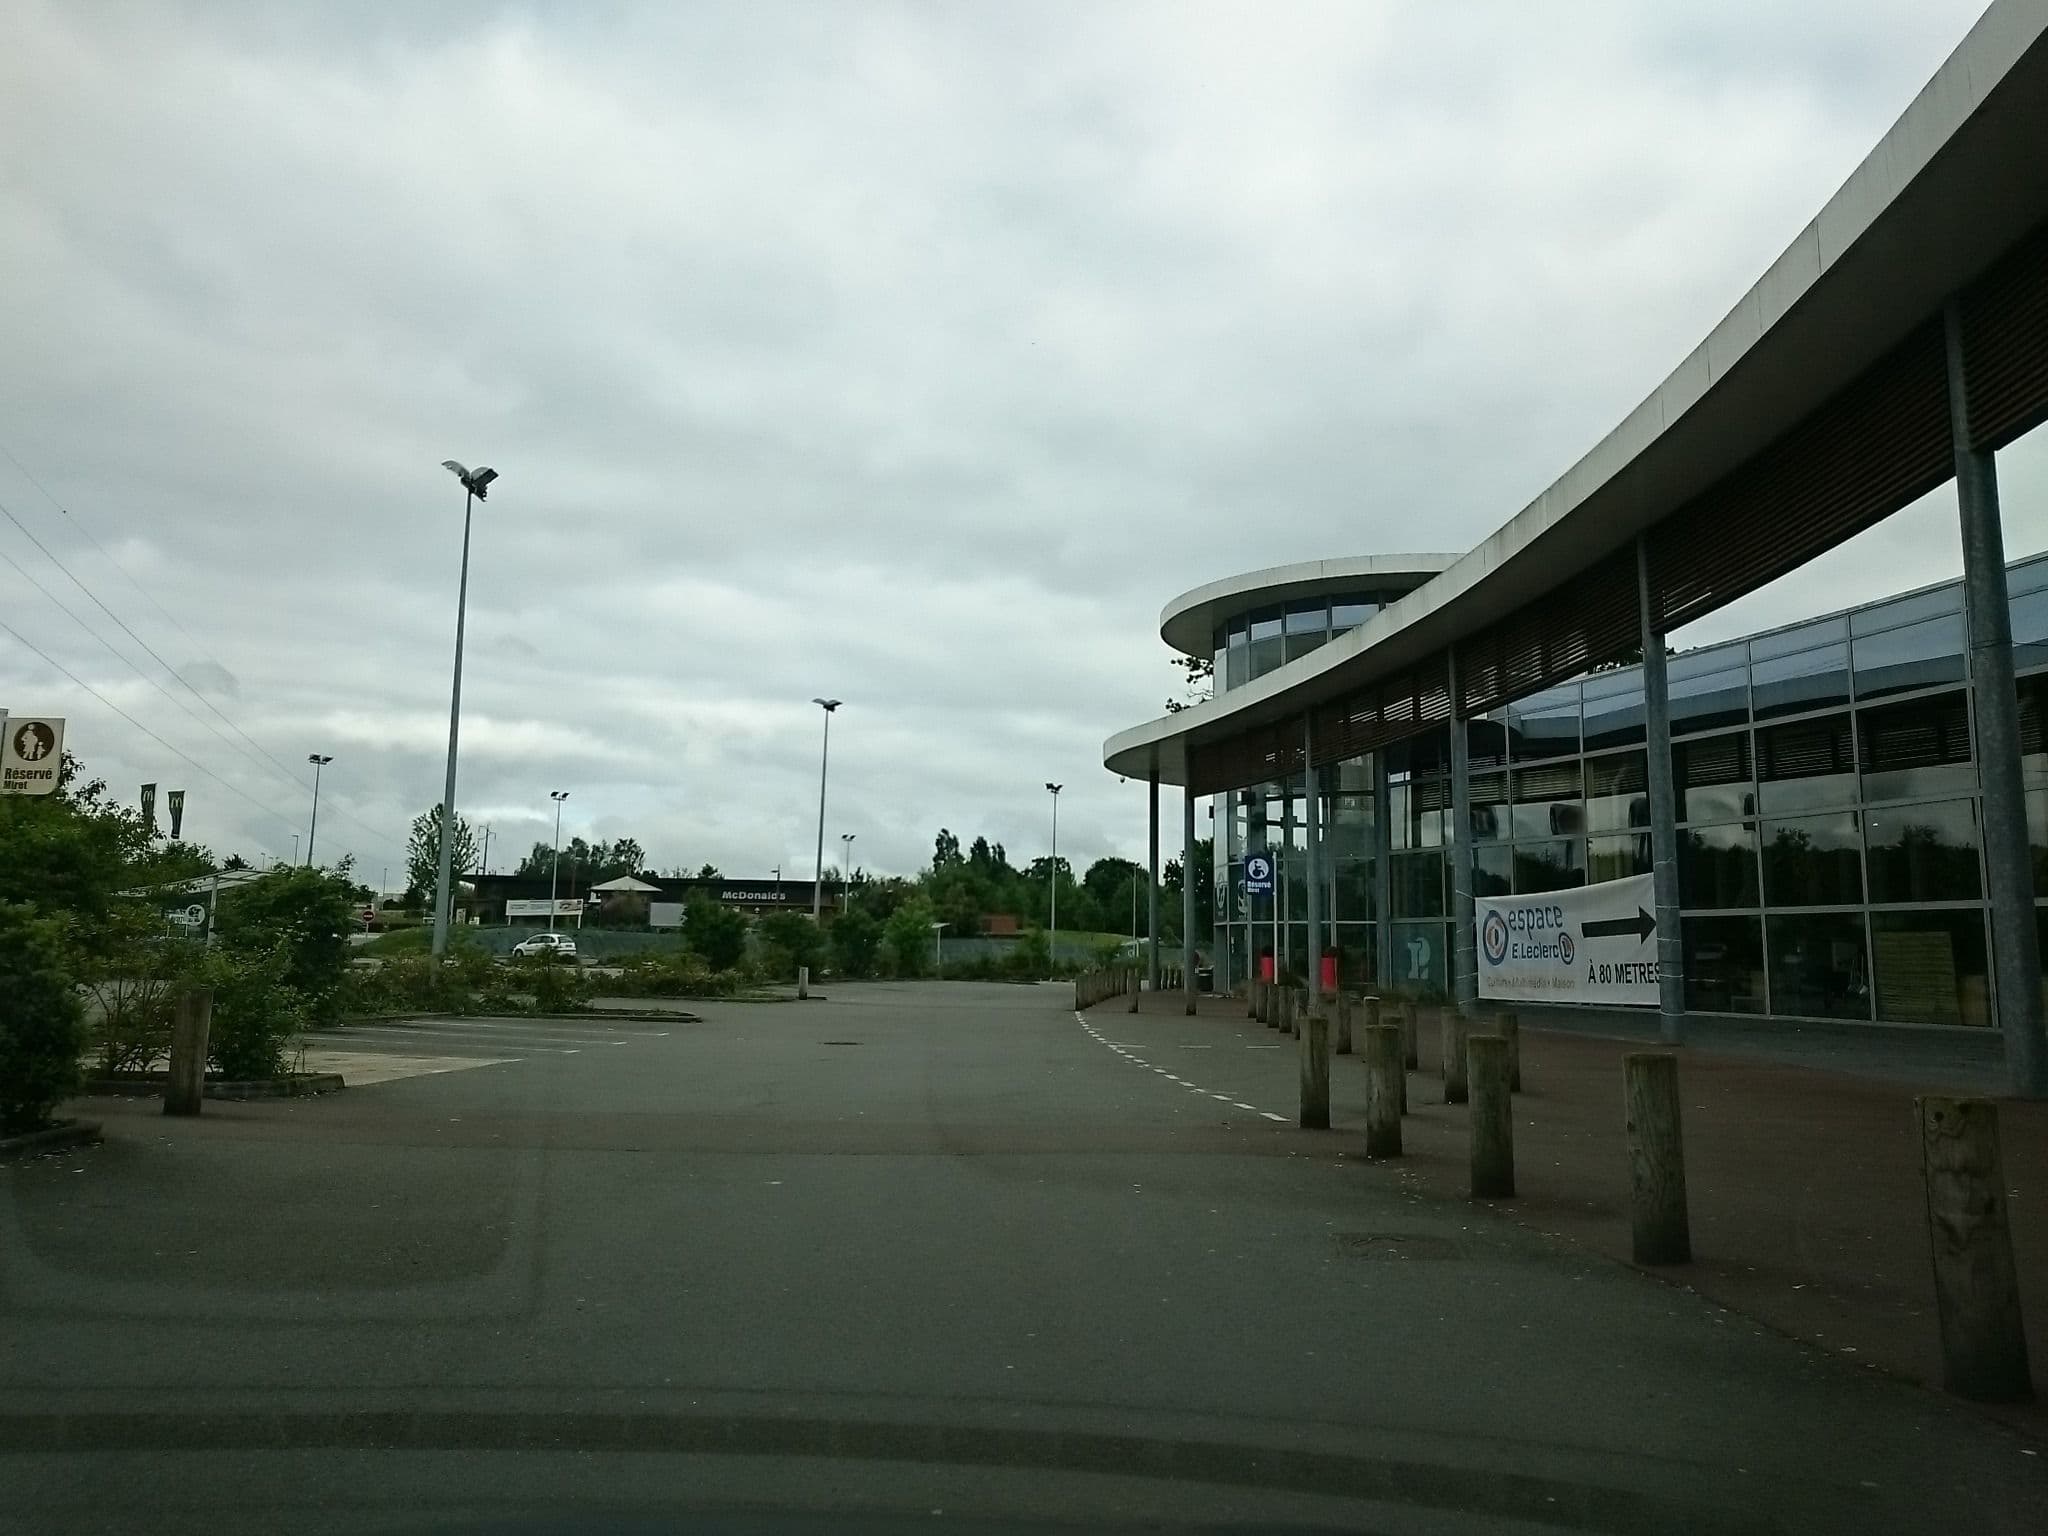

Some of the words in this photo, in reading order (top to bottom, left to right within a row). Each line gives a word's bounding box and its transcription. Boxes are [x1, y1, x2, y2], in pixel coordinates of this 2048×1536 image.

[4, 767, 53, 779] Réservé
[722, 891, 786, 900] McDonalds
[1508, 905, 1563, 940] espace
[1512, 940, 1559, 959] E.Leclerc
[1588, 959, 1597, 984] À
[1599, 963, 1612, 984] 80
[1615, 962, 1660, 984] METRES
